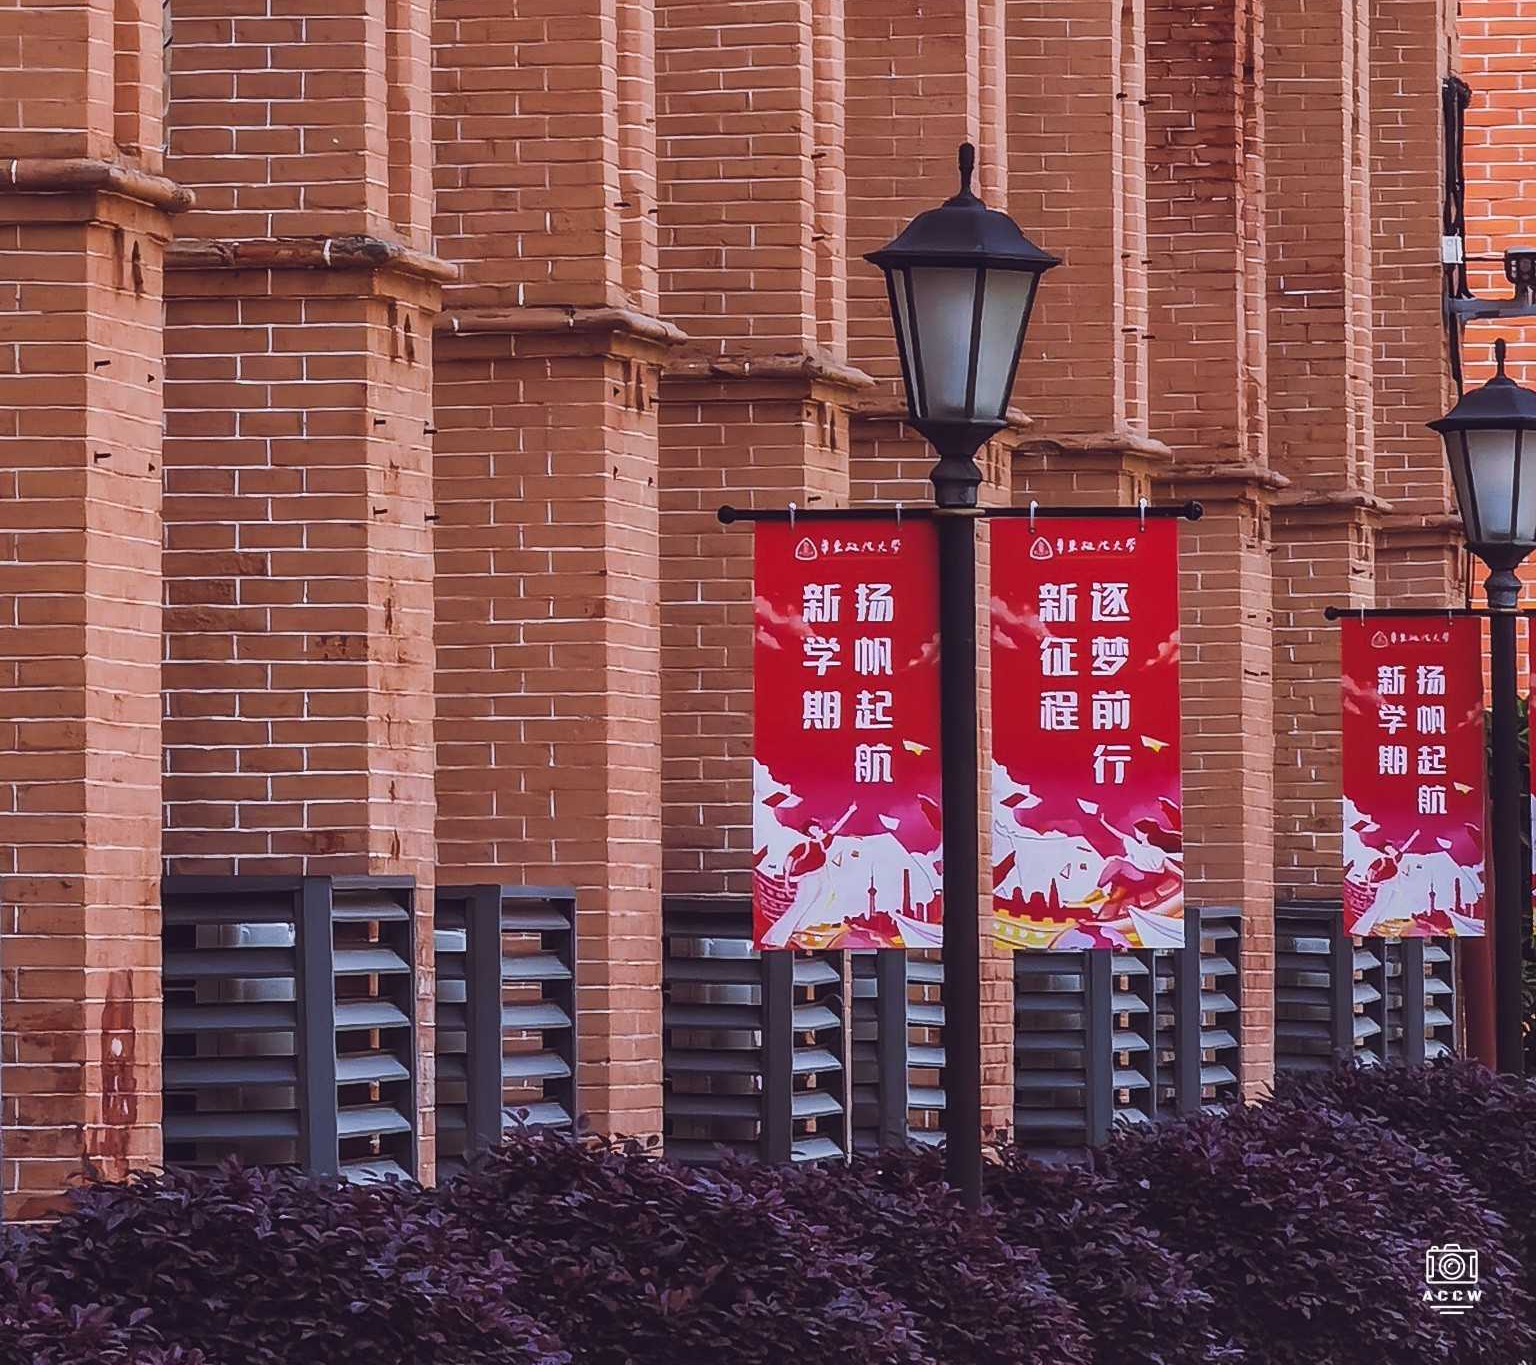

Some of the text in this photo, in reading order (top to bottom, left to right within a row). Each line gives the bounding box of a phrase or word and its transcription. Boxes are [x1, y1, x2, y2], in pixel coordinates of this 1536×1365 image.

[802, 583, 841, 730] 新学期
[854, 583, 894, 783] 扬帆起航
[1038, 582, 1079, 731] 新征程
[1090, 582, 1132, 784] 逐梦前行
[1377, 665, 1408, 775] 新学期
[1416, 665, 1448, 814] 扬帆起航
